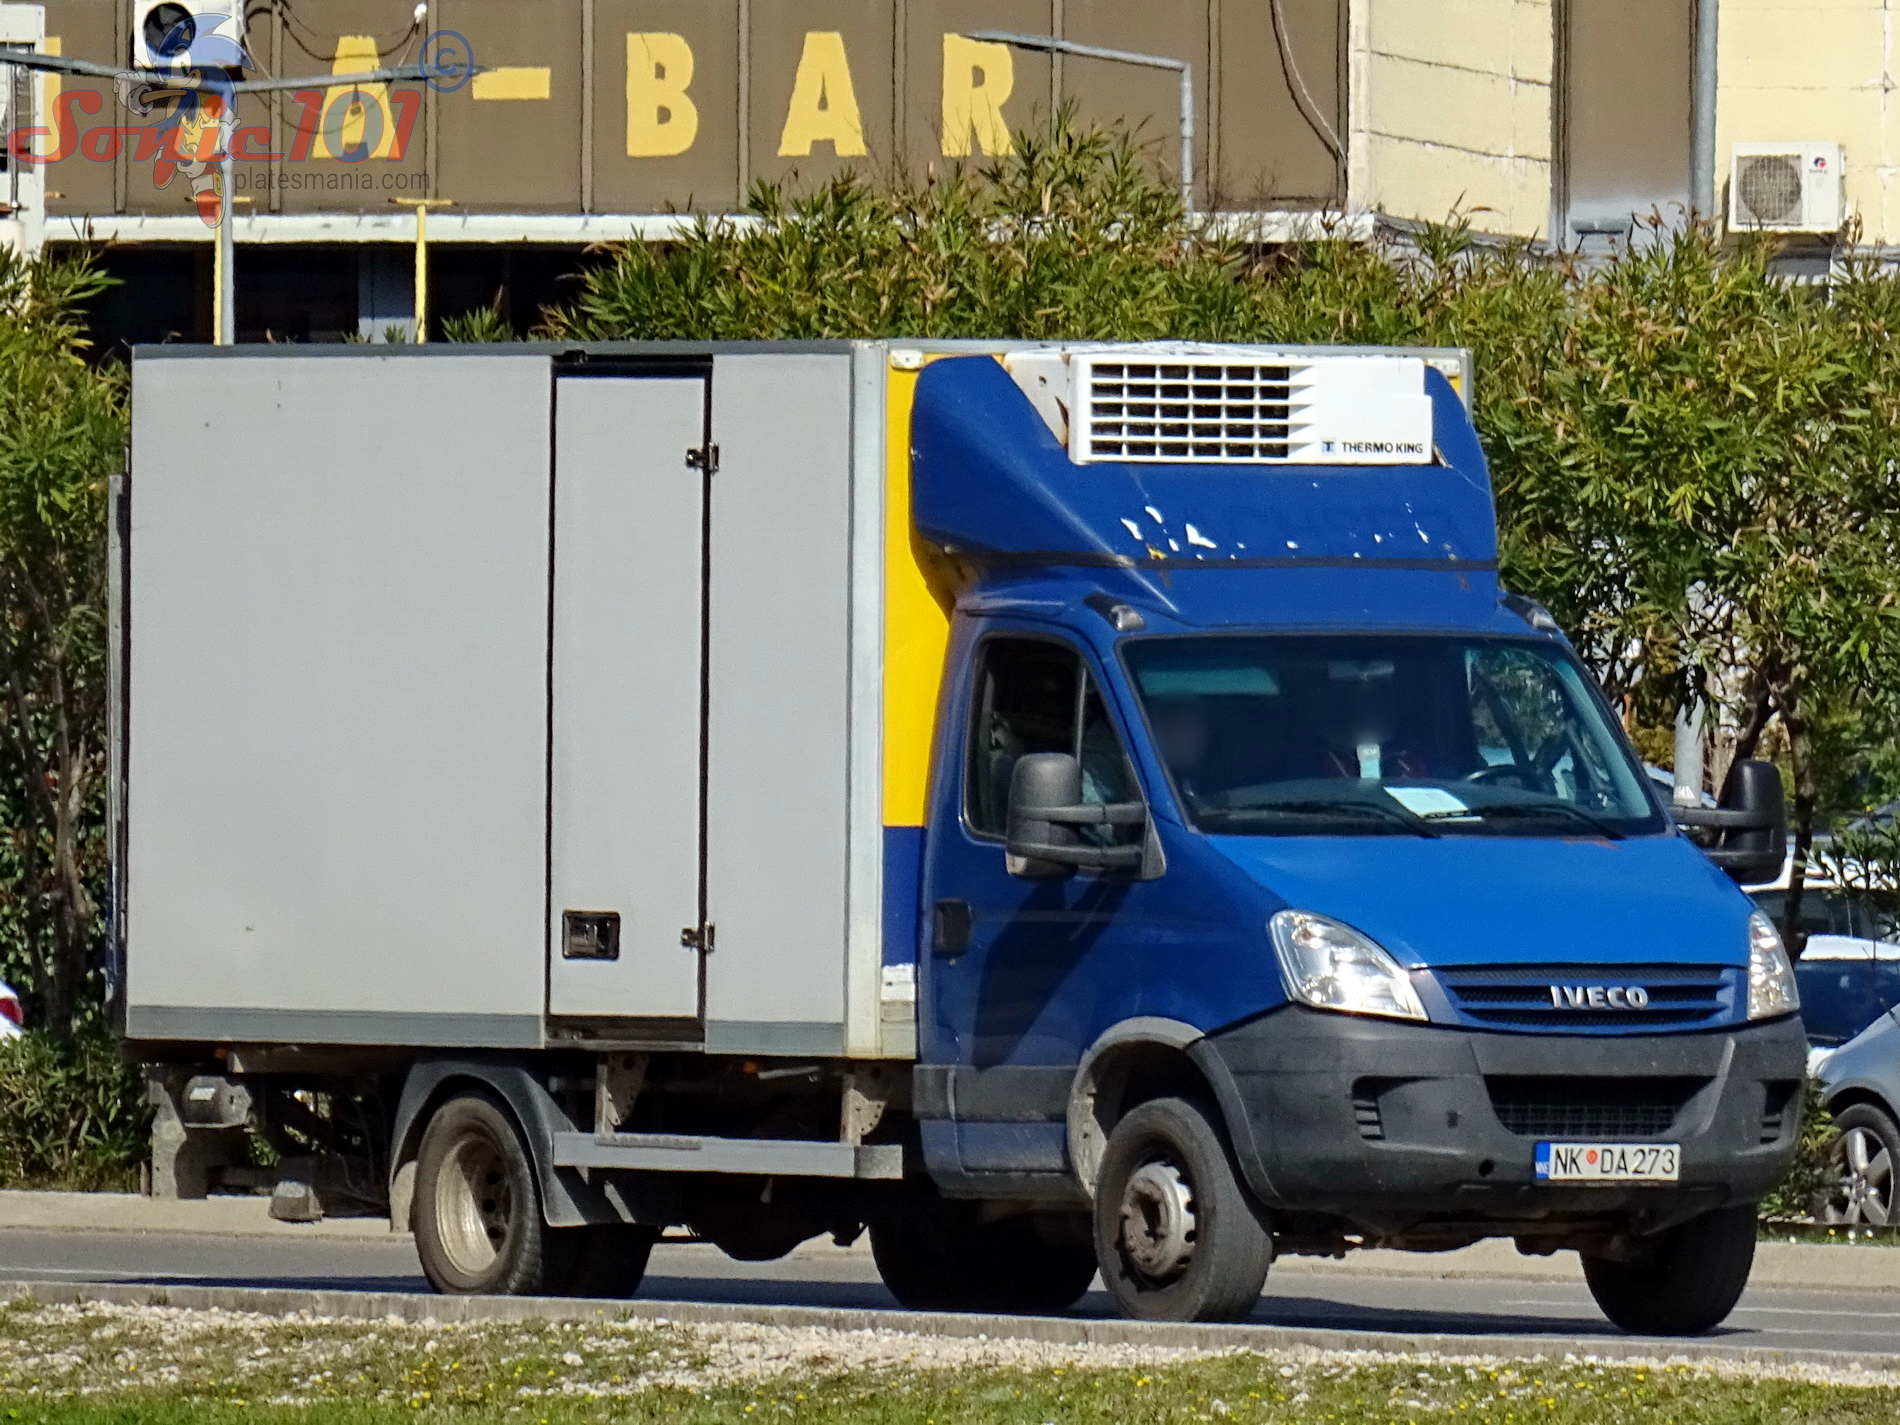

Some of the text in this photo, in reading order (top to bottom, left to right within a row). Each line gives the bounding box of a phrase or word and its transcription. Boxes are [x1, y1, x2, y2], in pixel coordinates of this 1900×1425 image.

[1342, 441, 1394, 454] THERMO
[1395, 442, 1424, 454] KING
[1550, 985, 1649, 1009] IVECO
[1554, 1147, 1583, 1175] NK
[1600, 1147, 1676, 1175] DA273
